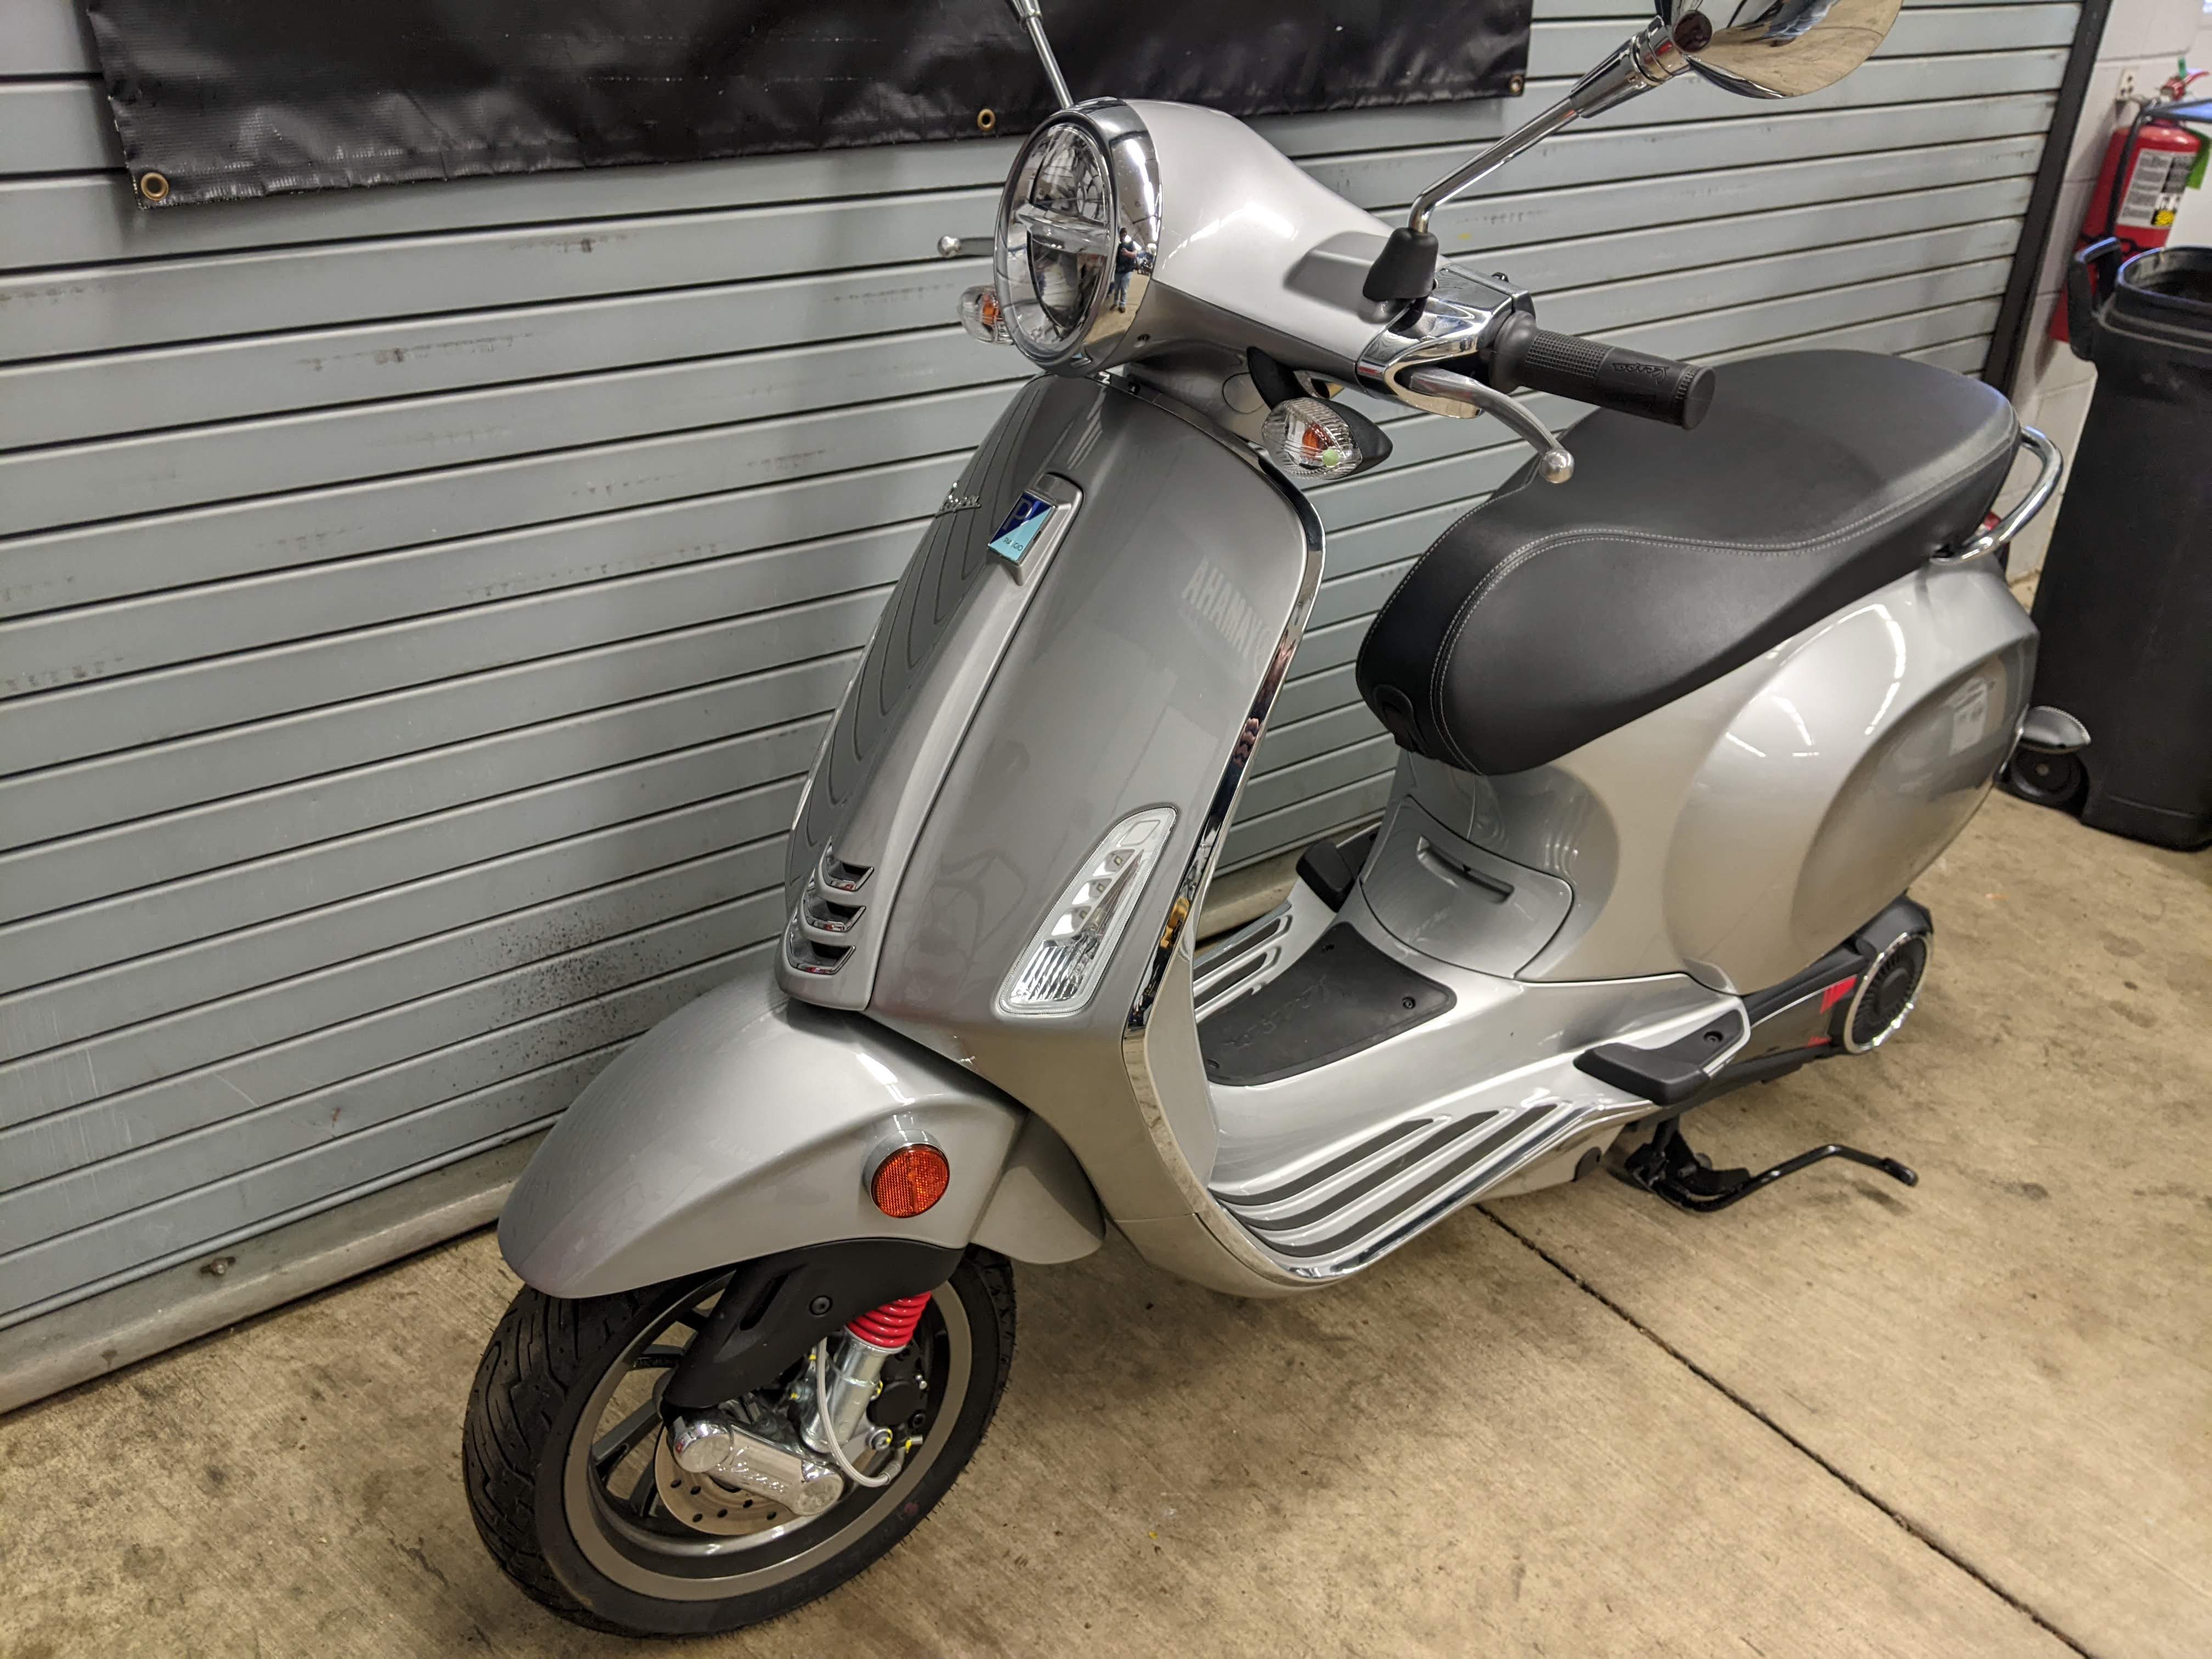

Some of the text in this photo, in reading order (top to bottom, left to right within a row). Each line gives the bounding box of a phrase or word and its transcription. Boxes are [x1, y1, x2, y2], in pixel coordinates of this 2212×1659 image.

[1611, 362, 1670, 385] Vespa
[1002, 497, 1032, 531] P
[1003, 537, 1024, 551] PIAGIO
